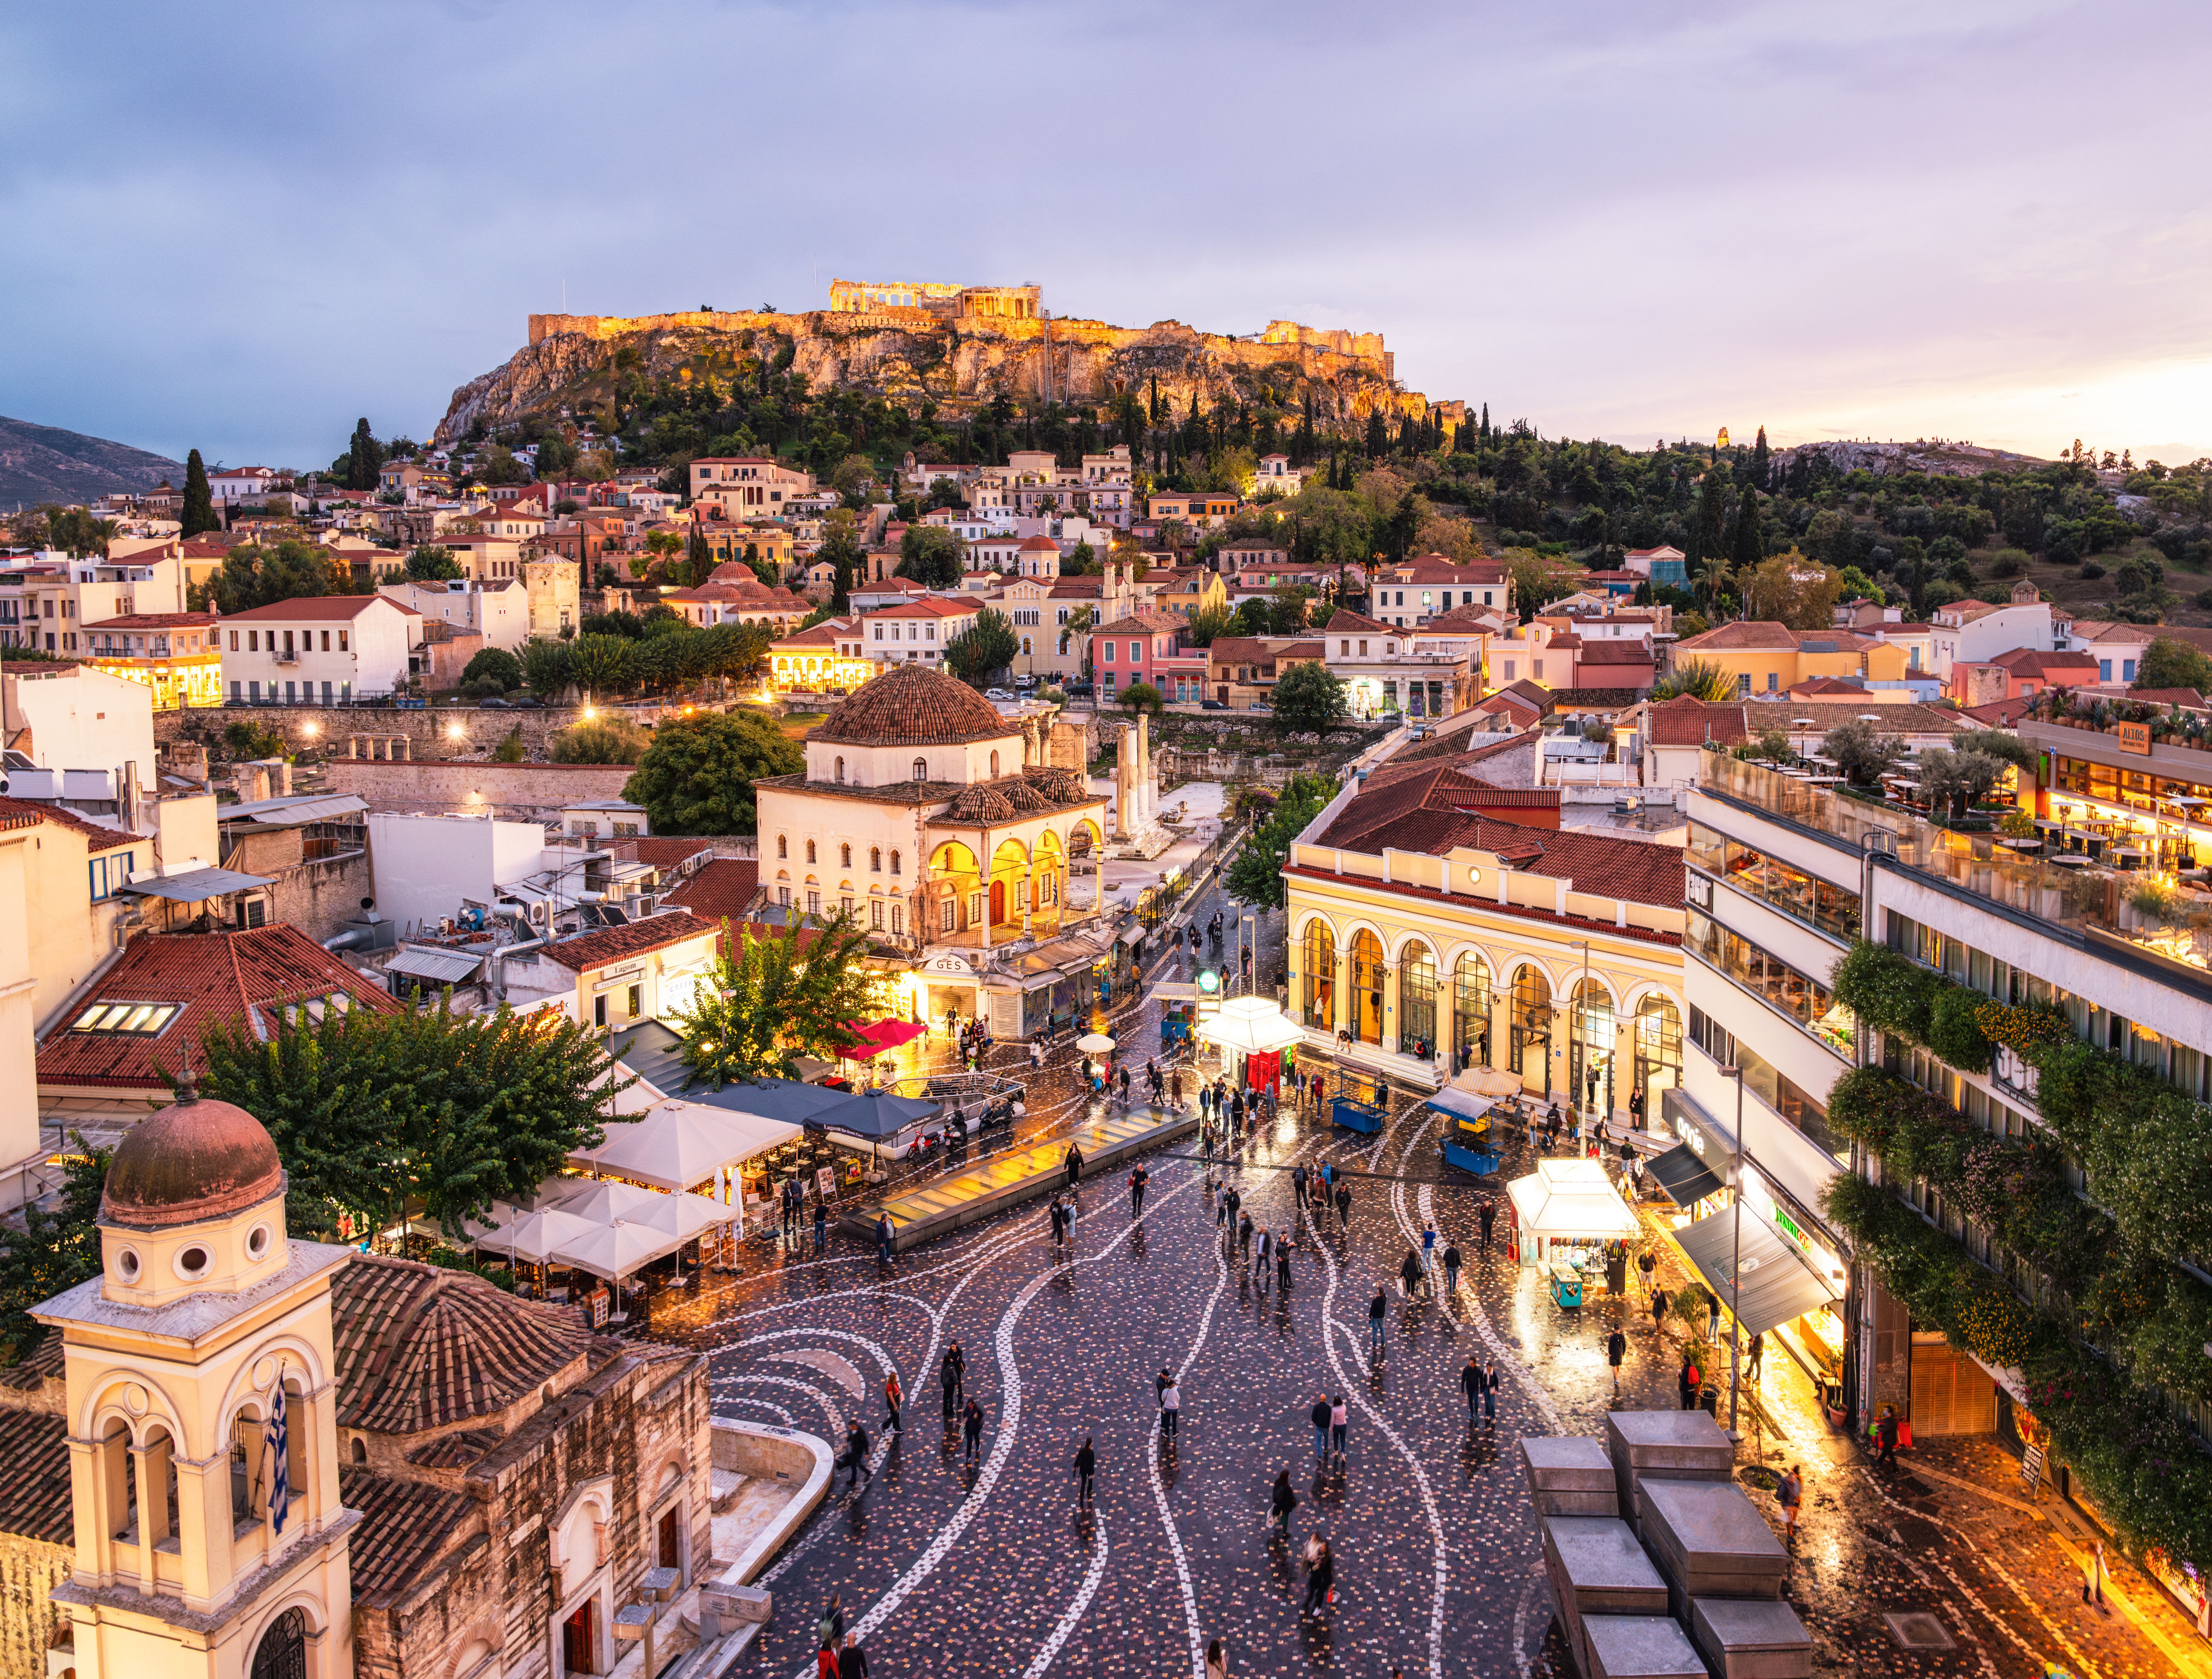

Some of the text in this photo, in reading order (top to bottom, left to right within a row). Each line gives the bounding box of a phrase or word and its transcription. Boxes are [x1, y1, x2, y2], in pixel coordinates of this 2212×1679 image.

[2123, 728, 2144, 742] ALTOS
[615, 963, 636, 973] Lagom
[937, 960, 961, 970] GES
[670, 980, 693, 992] GREEK
[527, 1000, 565, 1025] pject
[898, 1123, 912, 1134] Lagom
[1677, 1117, 1705, 1155] annie
[2025, 1454, 2040, 1469] ENTRANCE
